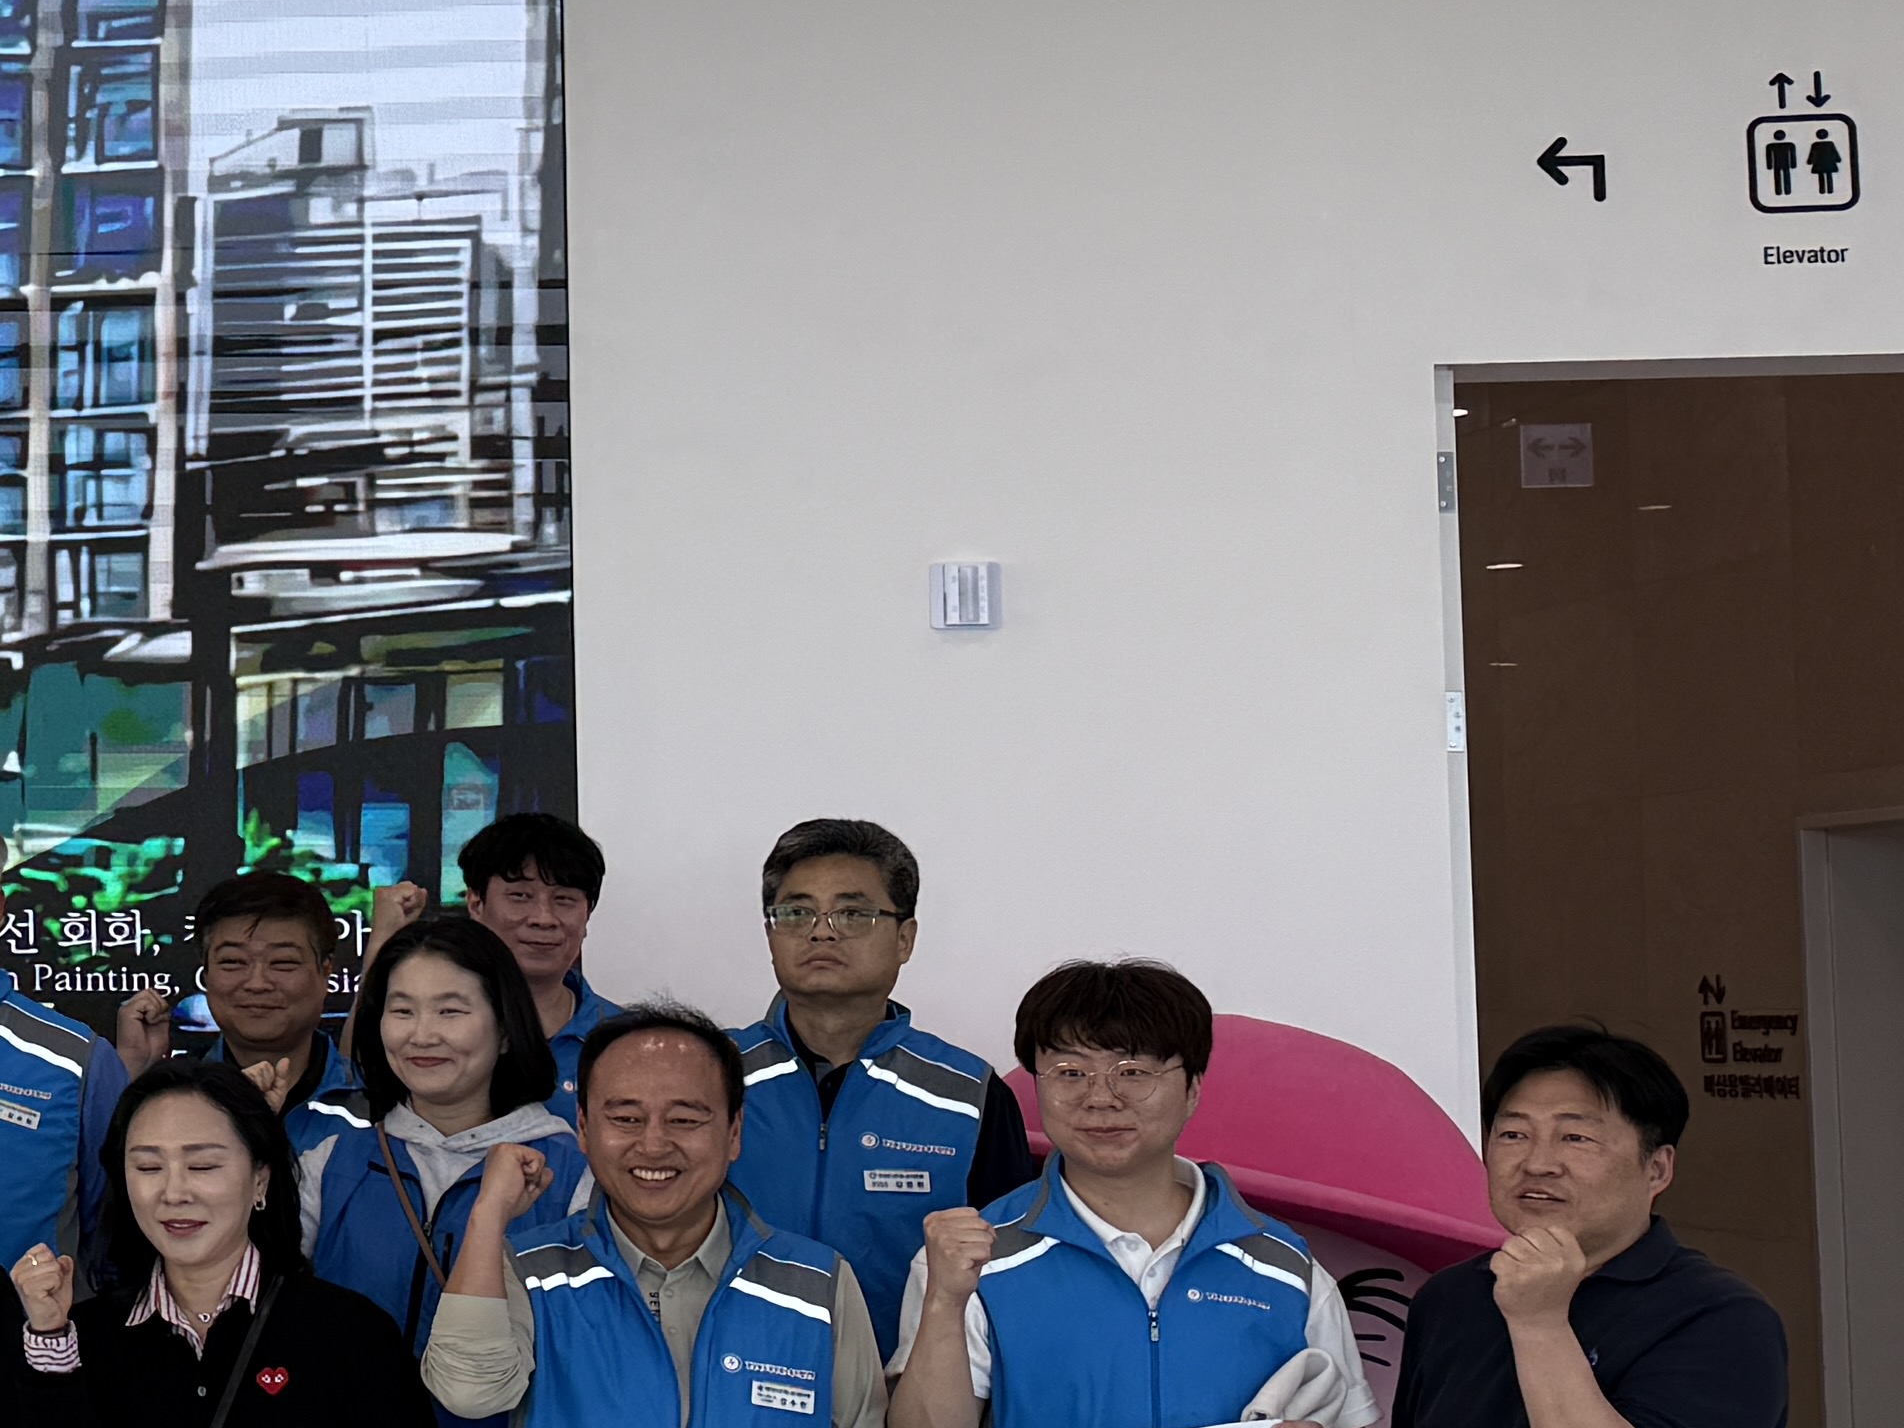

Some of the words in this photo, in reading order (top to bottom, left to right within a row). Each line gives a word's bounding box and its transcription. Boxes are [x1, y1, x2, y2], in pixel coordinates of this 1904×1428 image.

[1763, 245, 1850, 266] Elevator
[60, 908, 160, 957] 회화,
[34, 964, 180, 996] Painting,
